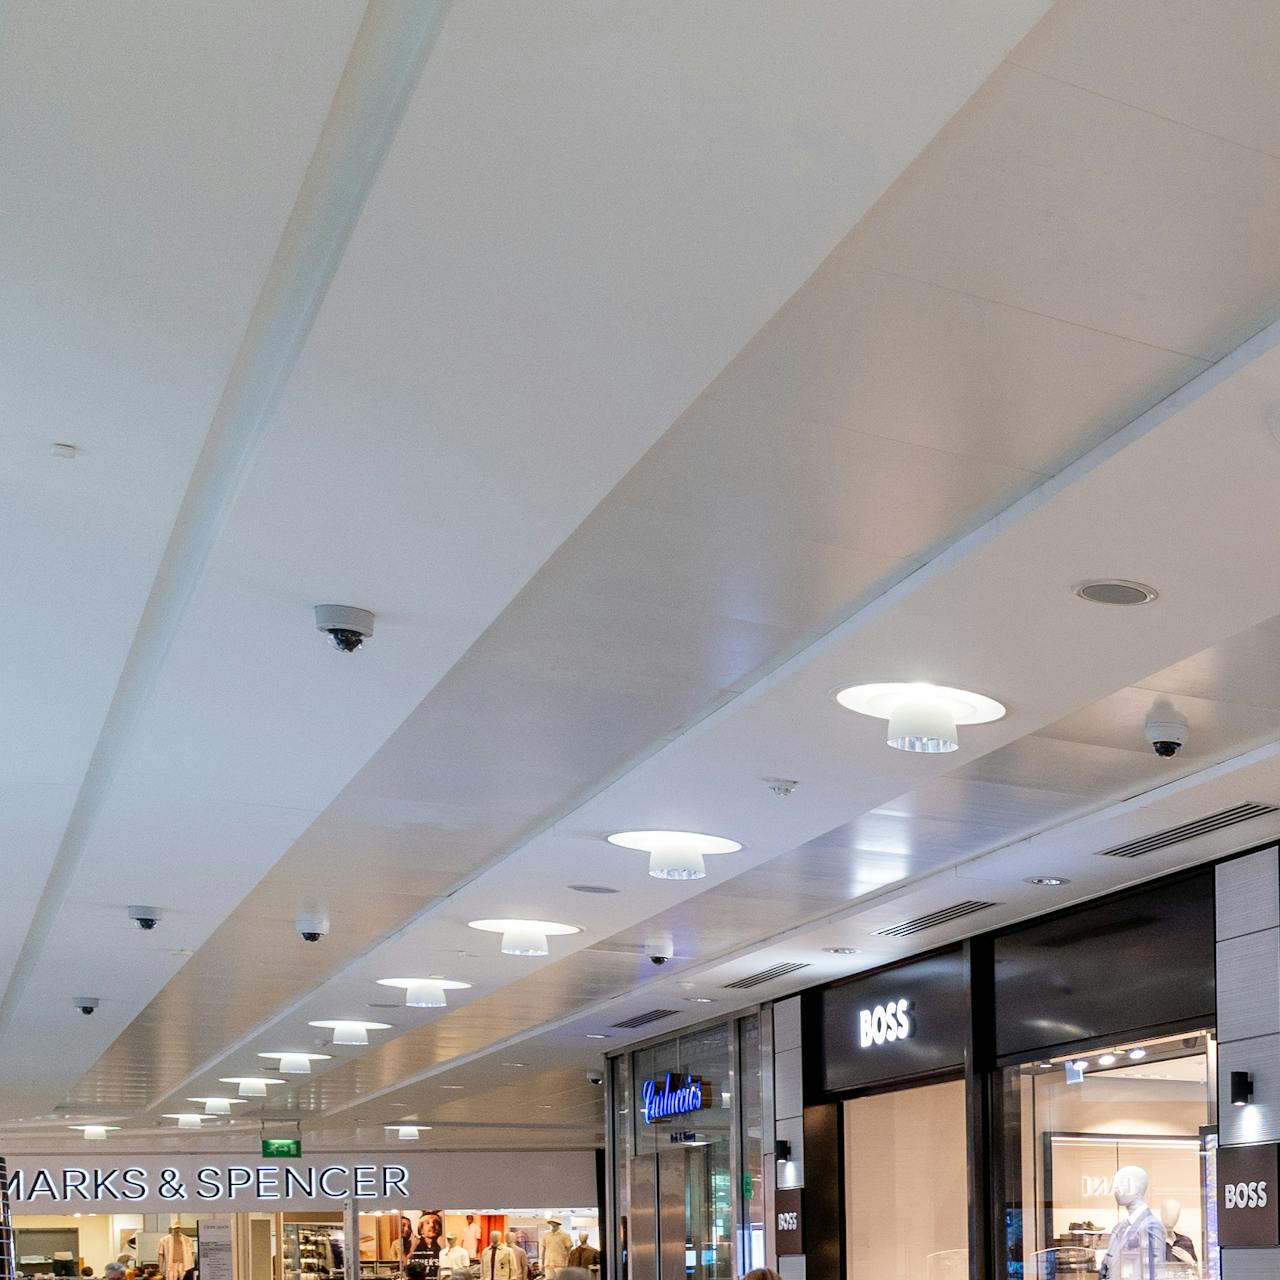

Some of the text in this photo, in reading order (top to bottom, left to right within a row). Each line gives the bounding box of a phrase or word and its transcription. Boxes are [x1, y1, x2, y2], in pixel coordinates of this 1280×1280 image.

[859, 998, 909, 1048] BOSS
[158, 1168, 187, 1201] &
[195, 1164, 410, 1200] SPENCER
[1224, 1181, 1267, 1209] BOSS
[778, 1212, 797, 1231] BOSS
